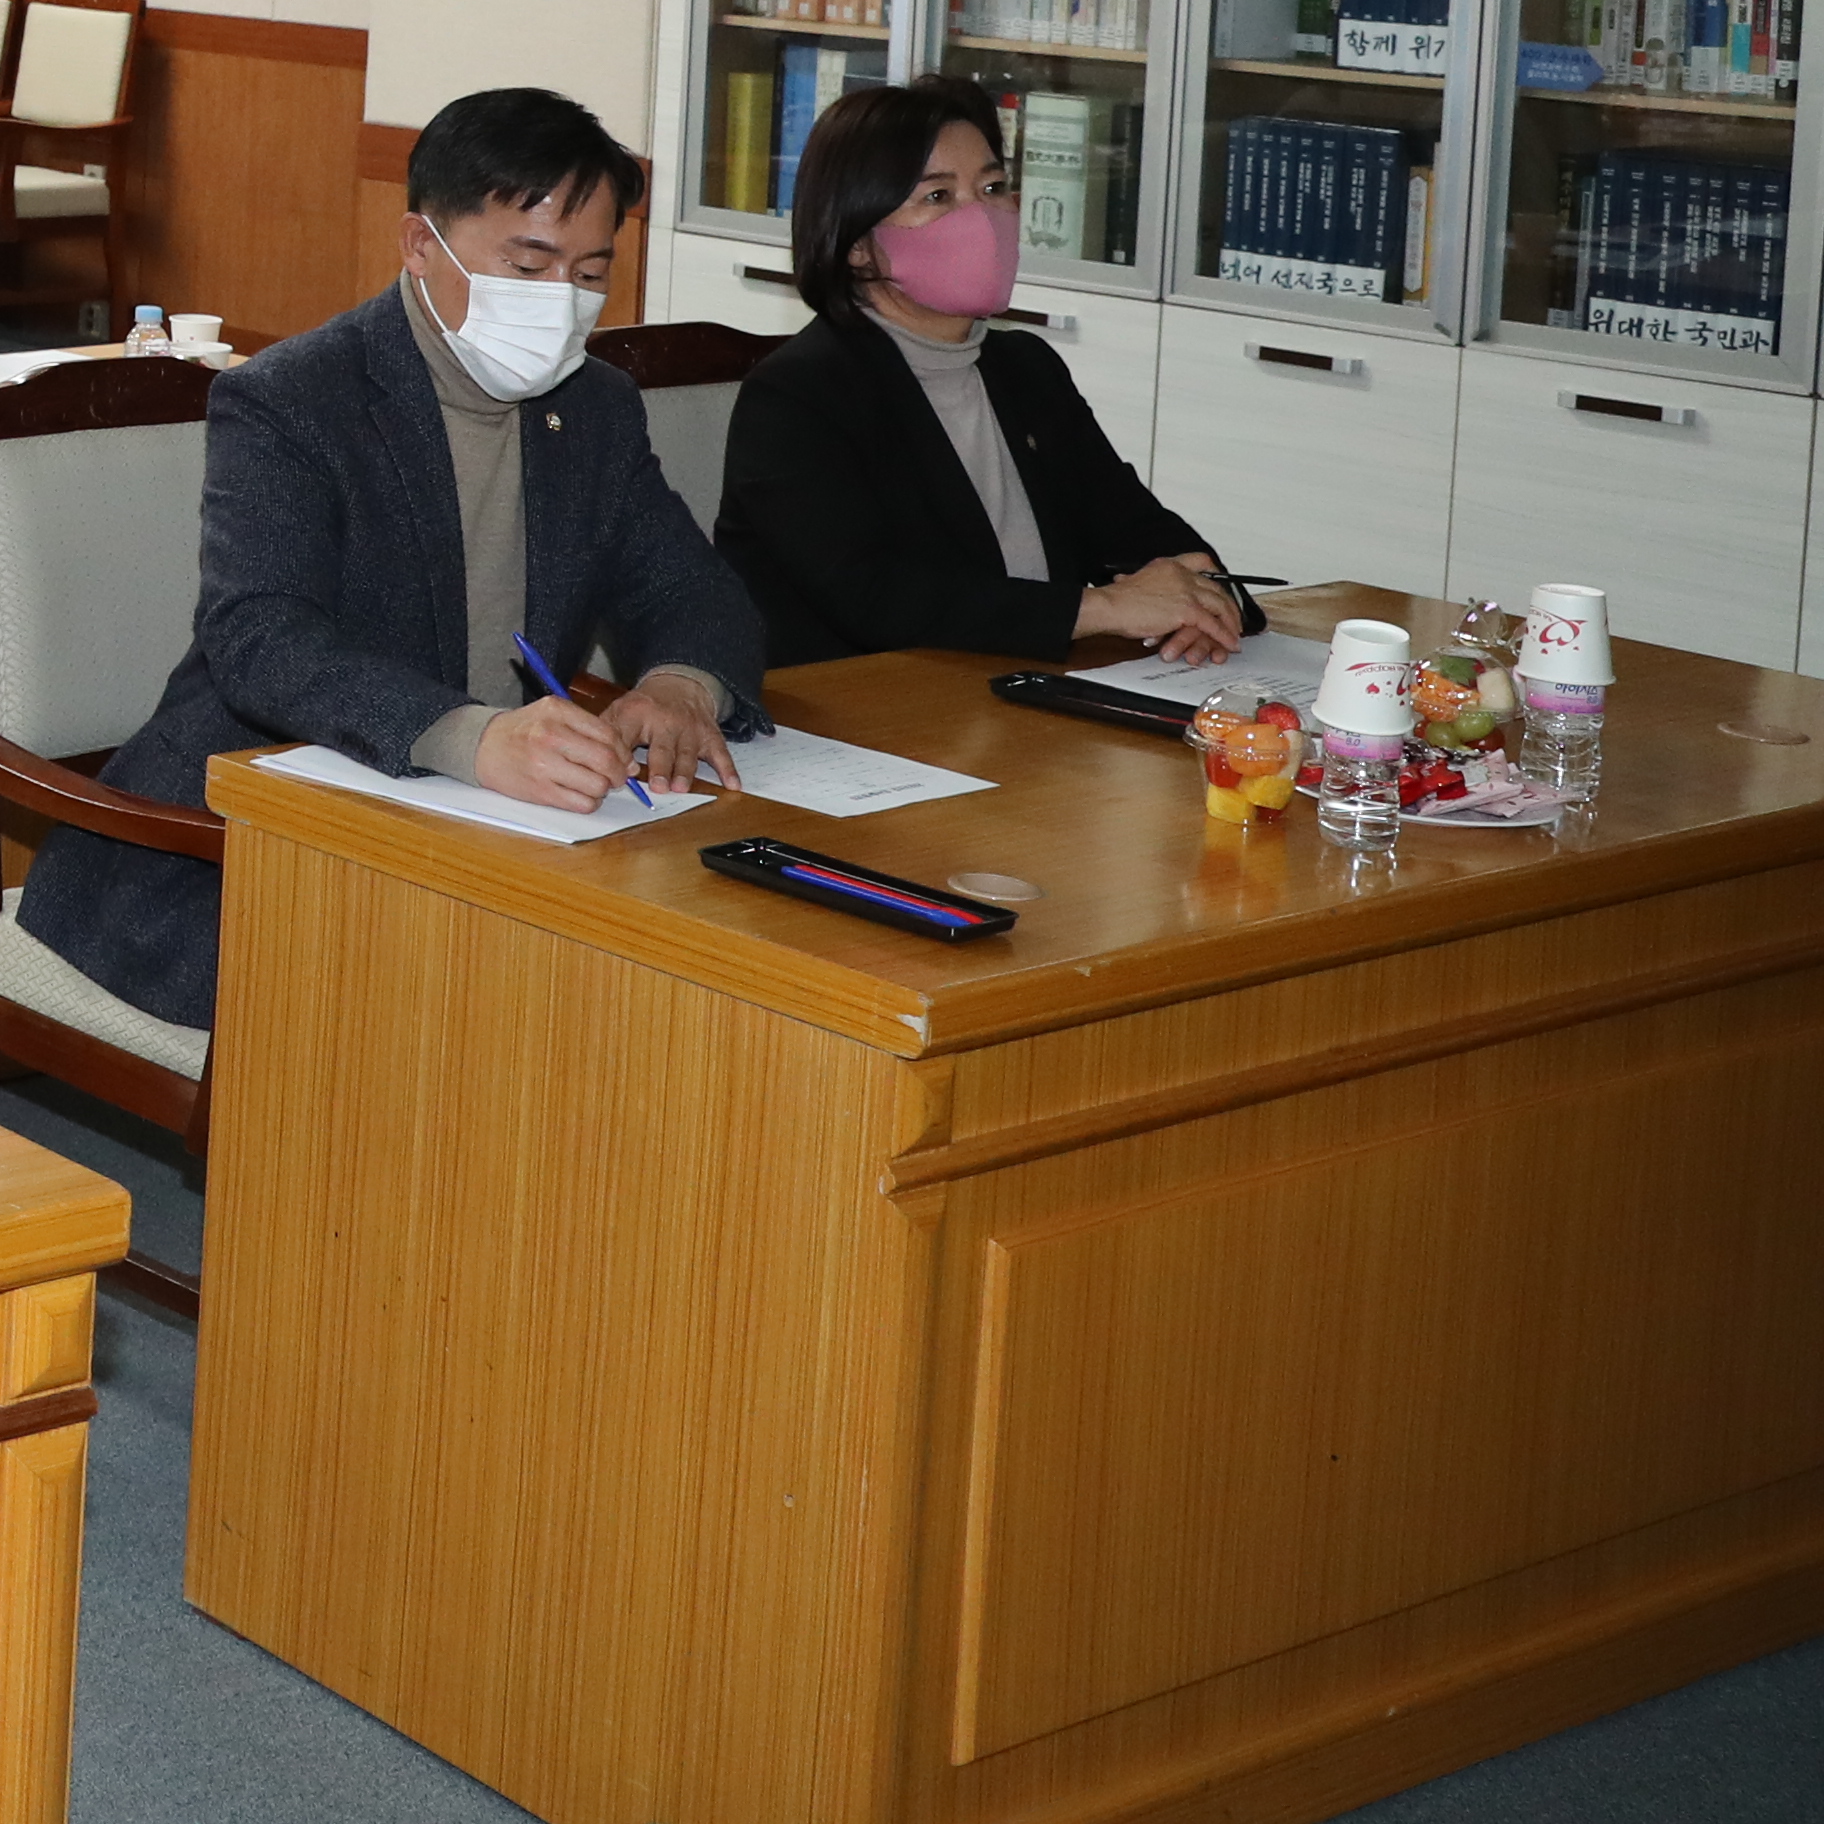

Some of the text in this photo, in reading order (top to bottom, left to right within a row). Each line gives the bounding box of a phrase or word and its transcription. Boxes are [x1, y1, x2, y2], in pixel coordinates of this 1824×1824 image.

[1343, 28, 1398, 57] 함께
[1270, 269, 1382, 299] 선진국으로
[1588, 308, 1770, 354] 위대한 국민과
